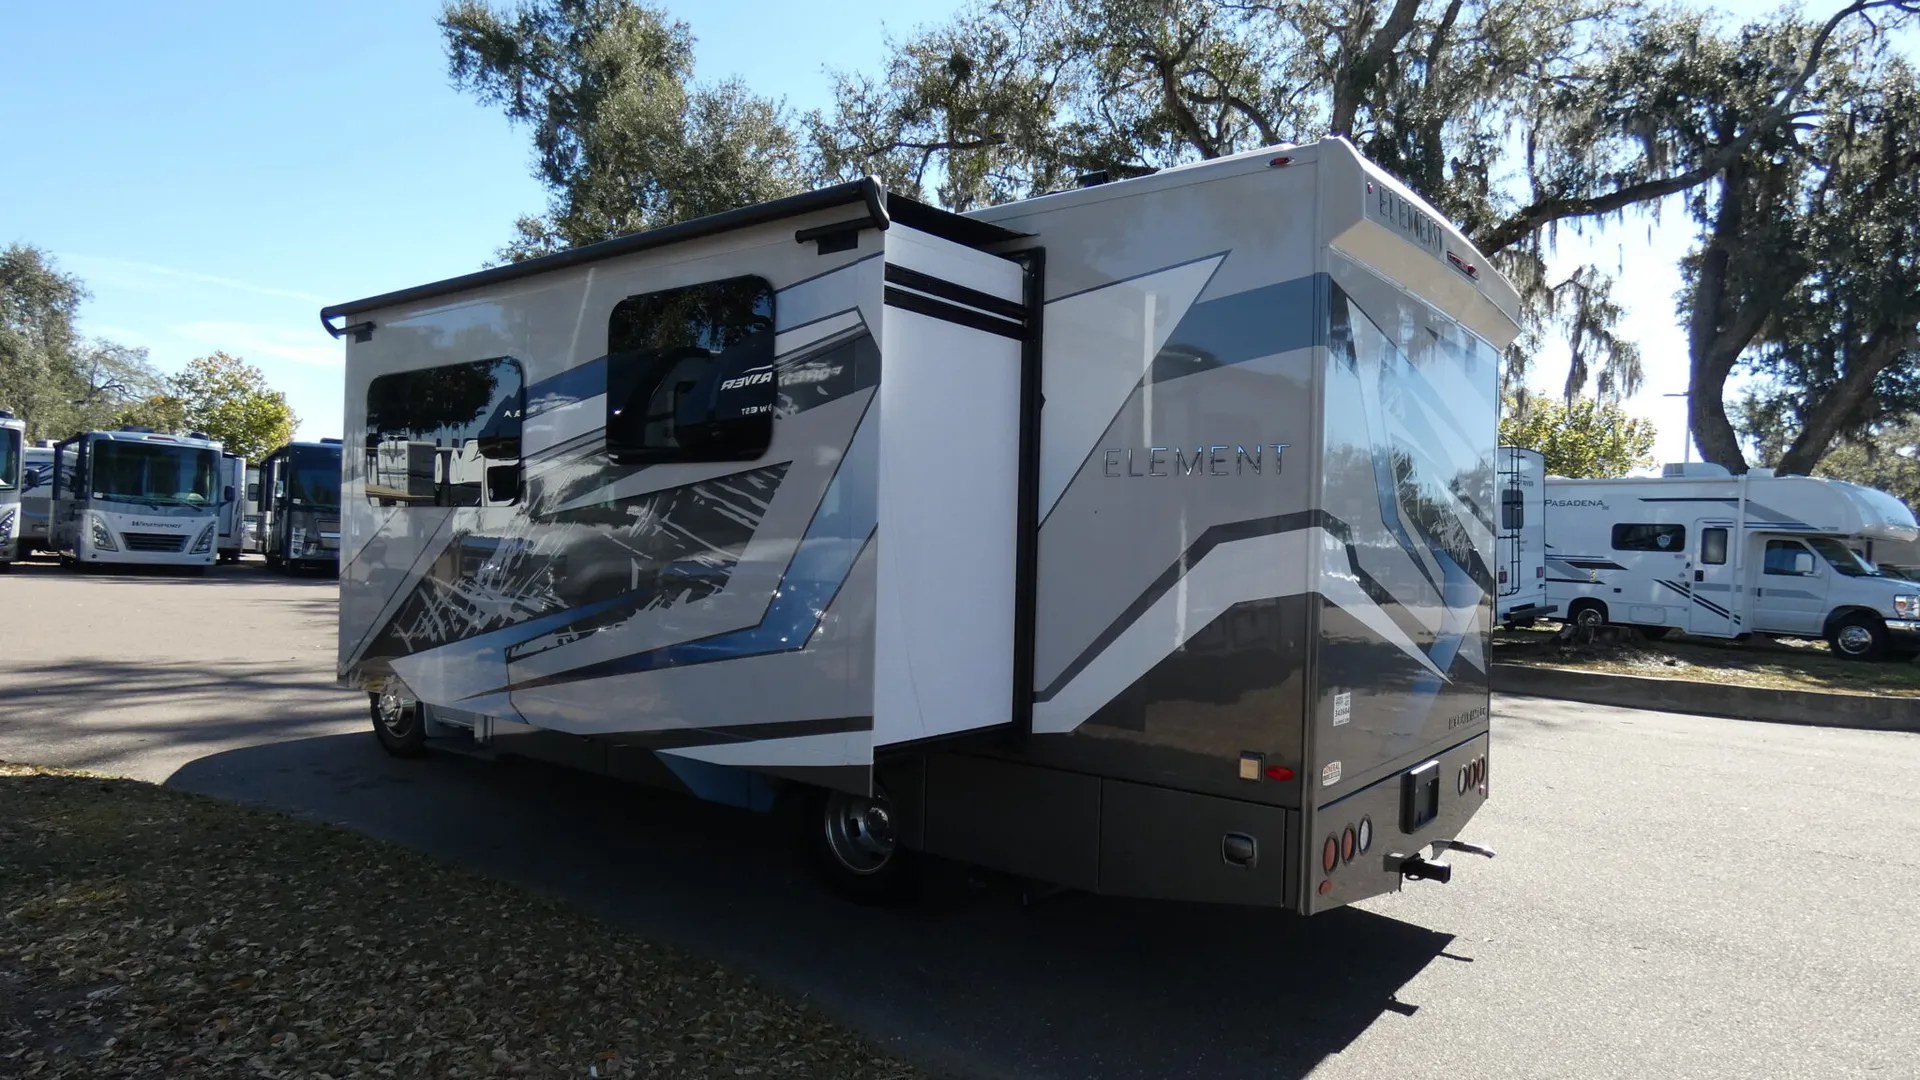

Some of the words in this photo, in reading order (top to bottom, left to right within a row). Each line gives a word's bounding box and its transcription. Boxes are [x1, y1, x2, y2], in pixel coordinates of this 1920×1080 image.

[1379, 184, 1443, 253] ELEMENT
[1103, 443, 1291, 478] ELEMENT
[1544, 499, 1604, 507] PASADENA
